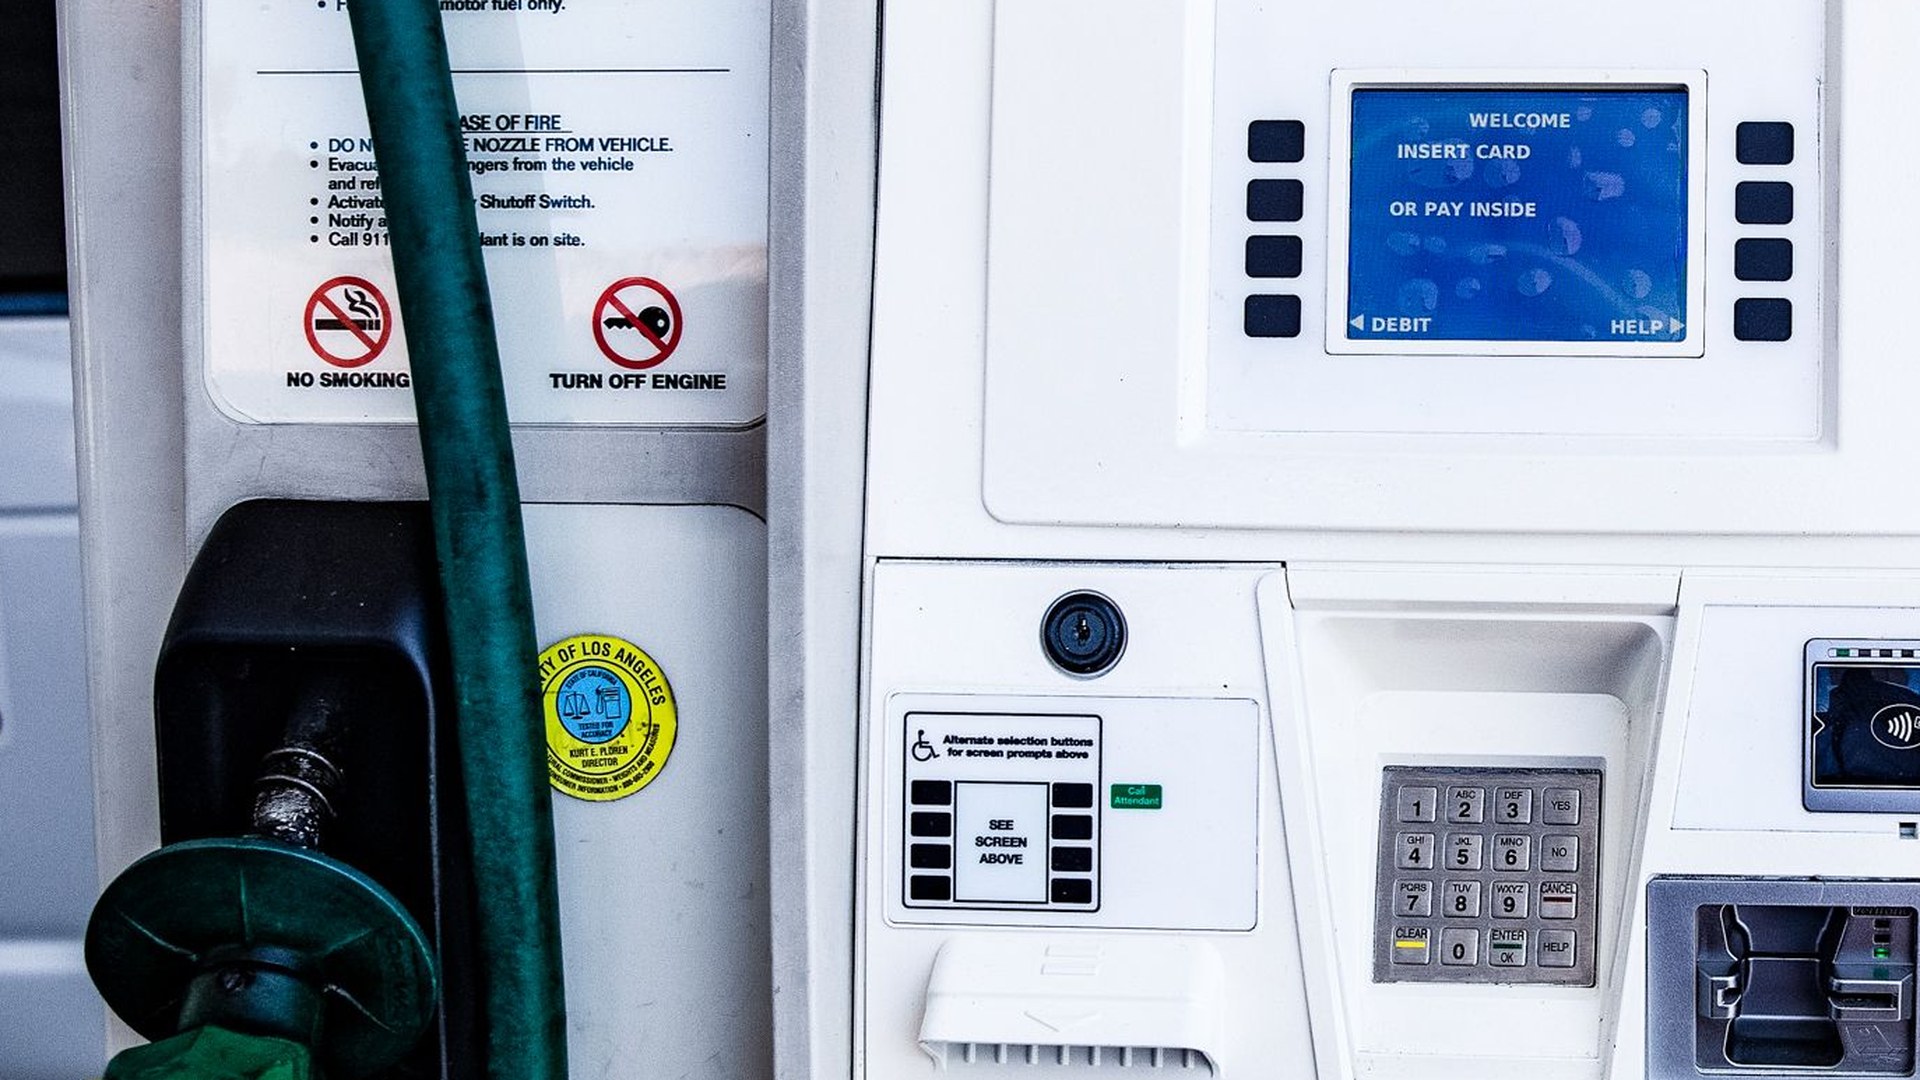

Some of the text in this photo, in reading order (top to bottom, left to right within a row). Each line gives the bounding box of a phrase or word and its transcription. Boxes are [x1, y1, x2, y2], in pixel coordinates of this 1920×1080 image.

[439, 0, 566, 14] motor fuel only.
[460, 114, 562, 131] ASE OF FIRE
[1469, 112, 1572, 129] WELCOME
[329, 138, 355, 153] DO
[473, 137, 541, 152] NOZZLE
[545, 137, 594, 152] FROM
[598, 137, 673, 152] VEHICLE.
[1397, 144, 1531, 160] INSERT CARD
[329, 156, 634, 175] Evacua ngers from the vehicle
[328, 177, 356, 190] and
[328, 193, 595, 209] Activat Shutoff Switch.
[1389, 201, 1537, 217] OR PAY INSIDE
[329, 213, 374, 231] Notify
[328, 232, 389, 247] Call 911
[512, 232, 525, 247] is
[529, 235, 548, 247] on
[553, 232, 585, 247] site.
[1371, 317, 1432, 333] DEBIT
[1611, 319, 1663, 334] HELP
[286, 372, 410, 389] NO SMOKING
[549, 373, 726, 390] TURN OFF ENGINE
[557, 640, 666, 706] OF LOS ANGELES
[942, 734, 1094, 747] Alternate selection buttons
[569, 748, 589, 758] KURT
[946, 747, 1089, 760] for screen prompts above
[581, 756, 618, 769] DIRECTOR
[1455, 790, 1476, 800] ABC
[1504, 791, 1523, 800] DEF
[1412, 800, 1421, 816] 1
[1458, 802, 1471, 818] 2
[1506, 802, 1519, 819] 3
[1551, 800, 1571, 811] YES
[989, 819, 1014, 831] SEE
[975, 836, 1028, 848] SCREEN
[1406, 836, 1425, 845] GHI
[1455, 837, 1473, 846] JKL
[1500, 837, 1524, 847] MNO
[979, 853, 1023, 865] ABOVE
[1408, 848, 1421, 864] 4
[1457, 849, 1469, 865] 5
[1505, 849, 1517, 866] 6
[1551, 847, 1568, 857] NO
[1452, 884, 1471, 893] TUV
[1496, 885, 1524, 894] WXYZ
[1540, 884, 1575, 894] CANCEL
[1406, 895, 1419, 911] 7
[1455, 896, 1467, 912] 8
[1503, 896, 1516, 913] 9
[1395, 928, 1428, 939] CLEAR
[1491, 930, 1525, 941] ENTER
[1452, 943, 1465, 960] 0
[1543, 942, 1569, 952] HELP
[1500, 953, 1514, 963] OK
